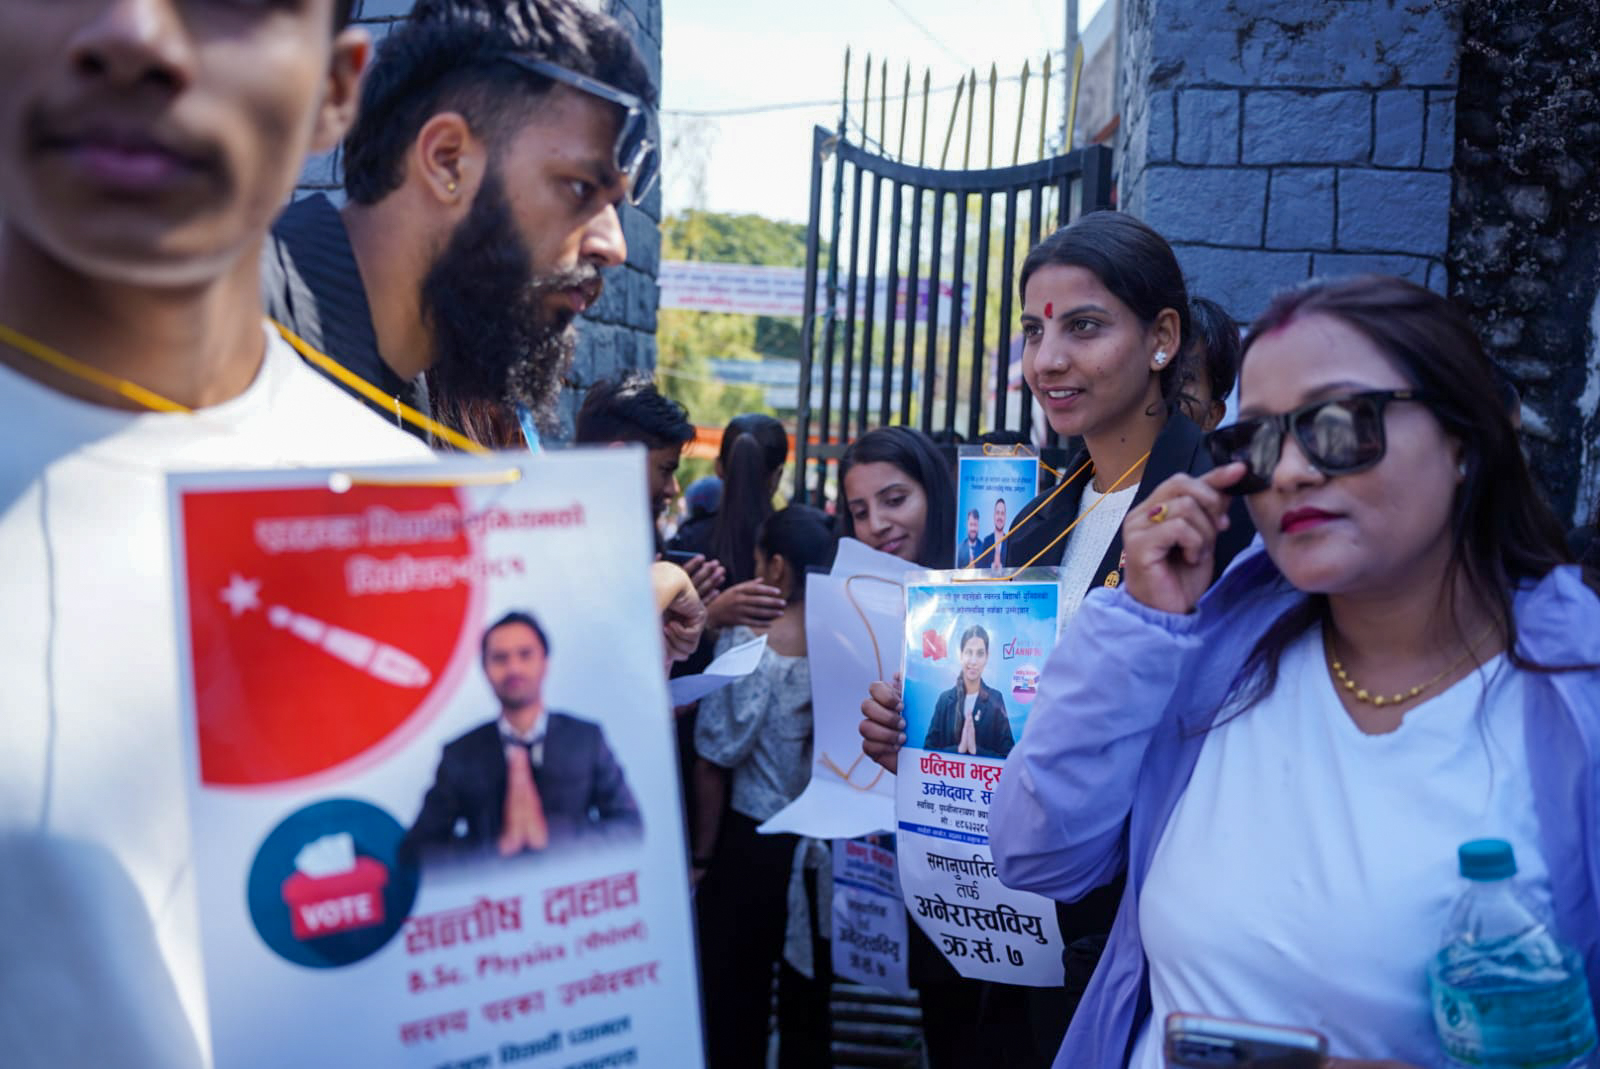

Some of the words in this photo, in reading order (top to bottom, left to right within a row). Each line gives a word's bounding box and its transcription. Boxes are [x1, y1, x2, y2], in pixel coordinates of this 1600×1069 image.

[920, 753, 966, 779] एलिसा
[954, 880, 981, 901] तर्फ
[300, 893, 375, 931] VOTE
[402, 894, 523, 954] सन्तोष
[544, 870, 640, 928] दाहाल
[914, 893, 1049, 945] अनेरास्ववियु
[476, 944, 566, 979] Physics
[1005, 944, 1025, 967] ७
